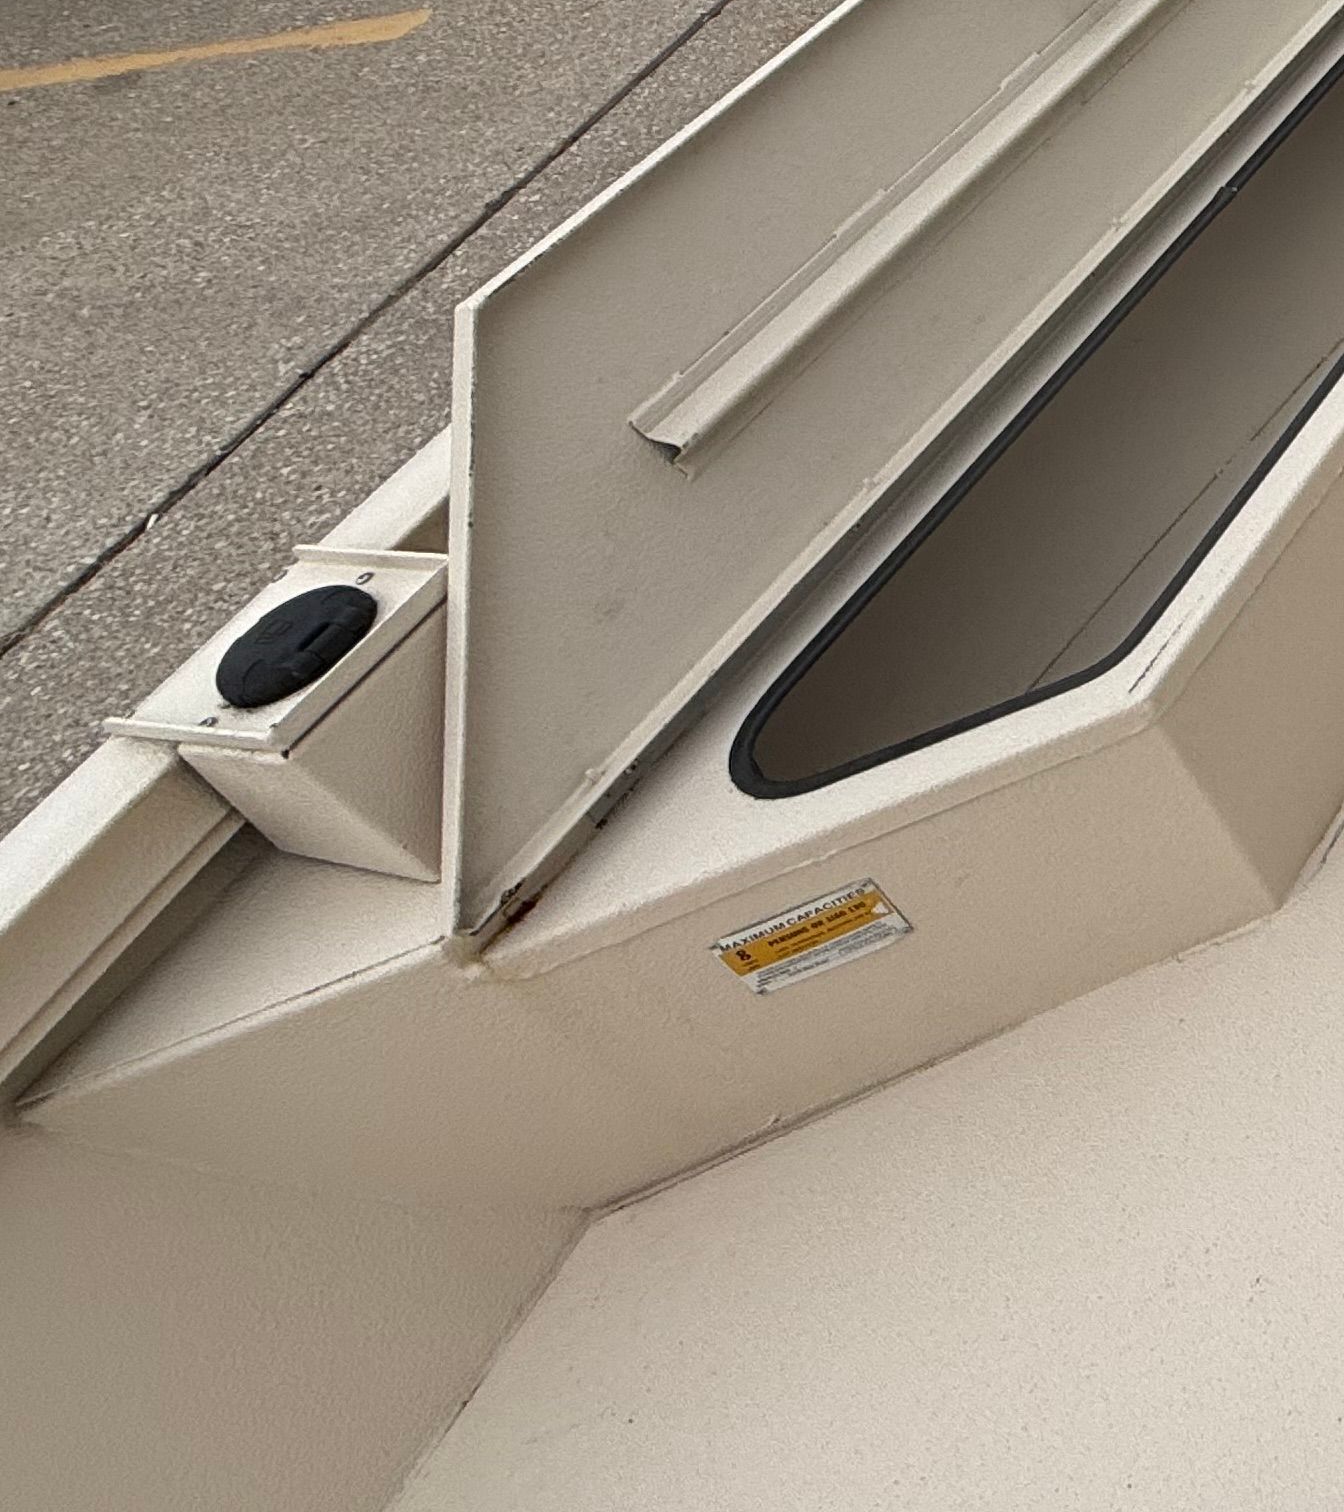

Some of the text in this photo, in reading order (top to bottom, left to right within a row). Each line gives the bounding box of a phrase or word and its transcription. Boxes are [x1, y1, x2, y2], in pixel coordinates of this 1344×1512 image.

[720, 922, 786, 952] MAXIMUM
[786, 888, 865, 926] CAPACITIES
[736, 949, 752, 961] 8
